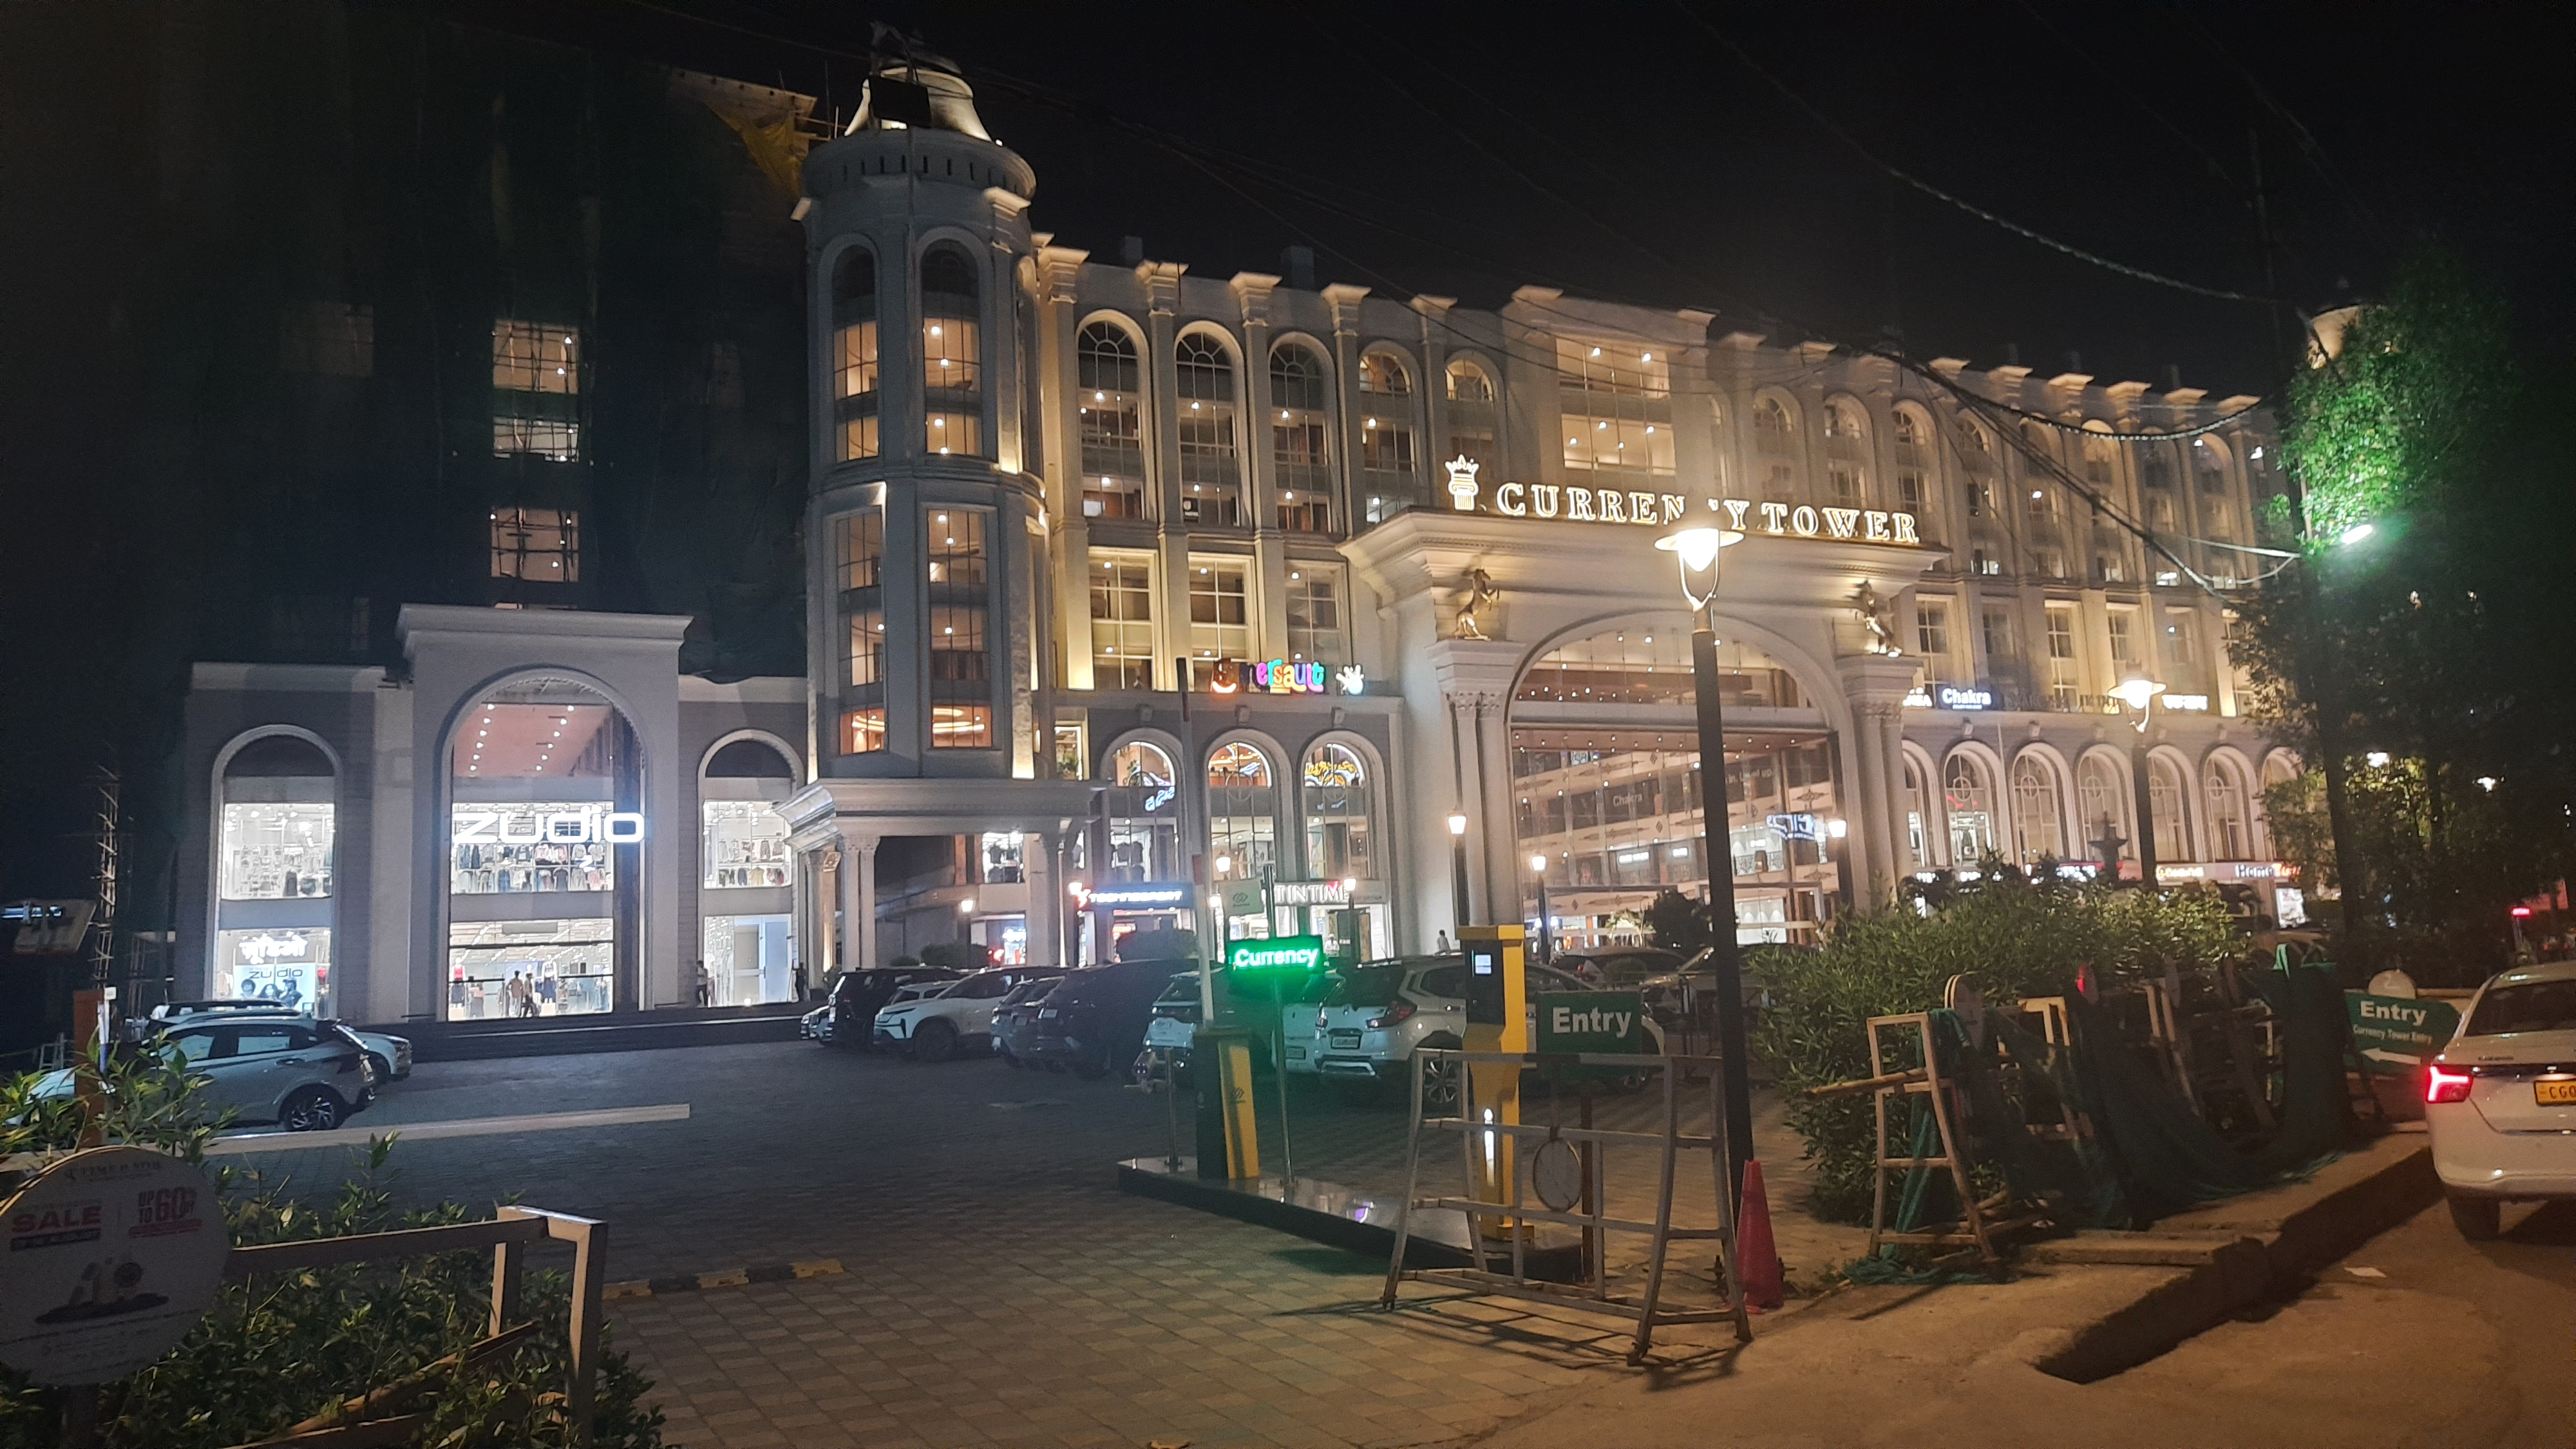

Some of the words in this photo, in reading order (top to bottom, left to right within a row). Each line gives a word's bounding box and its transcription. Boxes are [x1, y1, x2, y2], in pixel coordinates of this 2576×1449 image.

[1496, 482, 1750, 531] CURRENY
[1761, 501, 1920, 544] TOWER
[1942, 687, 1993, 705] Chakra
[1613, 792, 1643, 807] Chakra
[1235, 948, 1320, 969] Currency
[1553, 1006, 1632, 1038] Entry
[2360, 1000, 2427, 1026] Entry
[2353, 1023, 2385, 1041] Currency
[2387, 1028, 2410, 1042] Tower
[2410, 1031, 2433, 1045] Entry
[138, 1191, 155, 1207] UP
[11, 1206, 102, 1233] SALE
